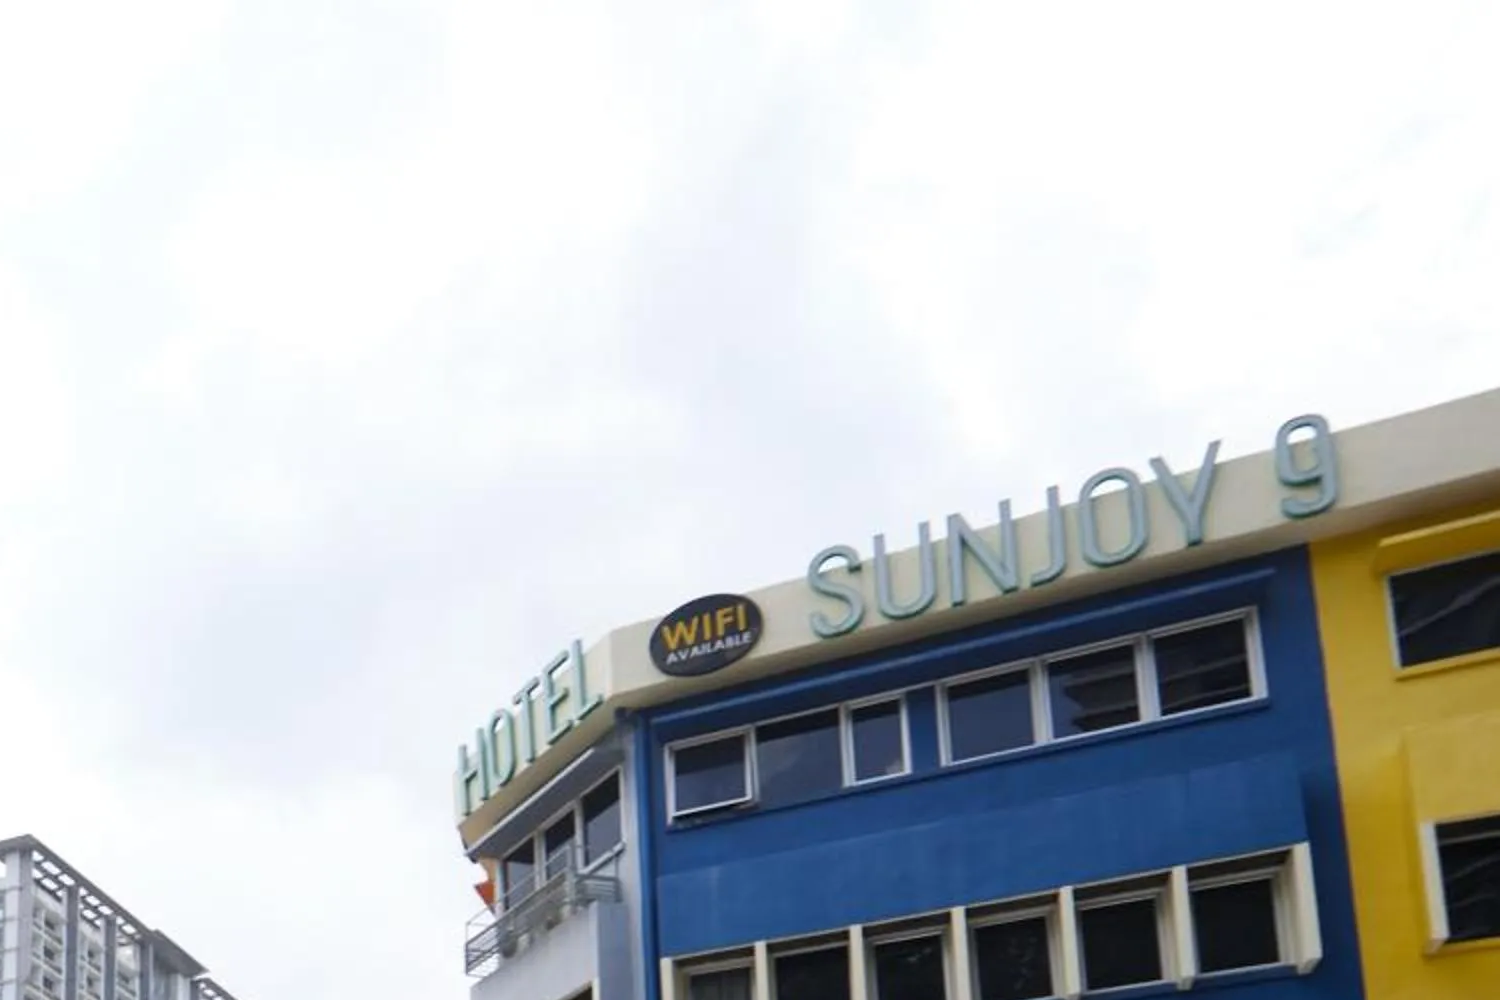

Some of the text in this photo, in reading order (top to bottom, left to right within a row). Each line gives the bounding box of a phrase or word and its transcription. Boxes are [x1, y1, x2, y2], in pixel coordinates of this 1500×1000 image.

[457, 413, 1341, 818] HOTEL SUNJOY 9
[661, 603, 748, 652] WIFI
[665, 631, 753, 665] AVAILABLE
